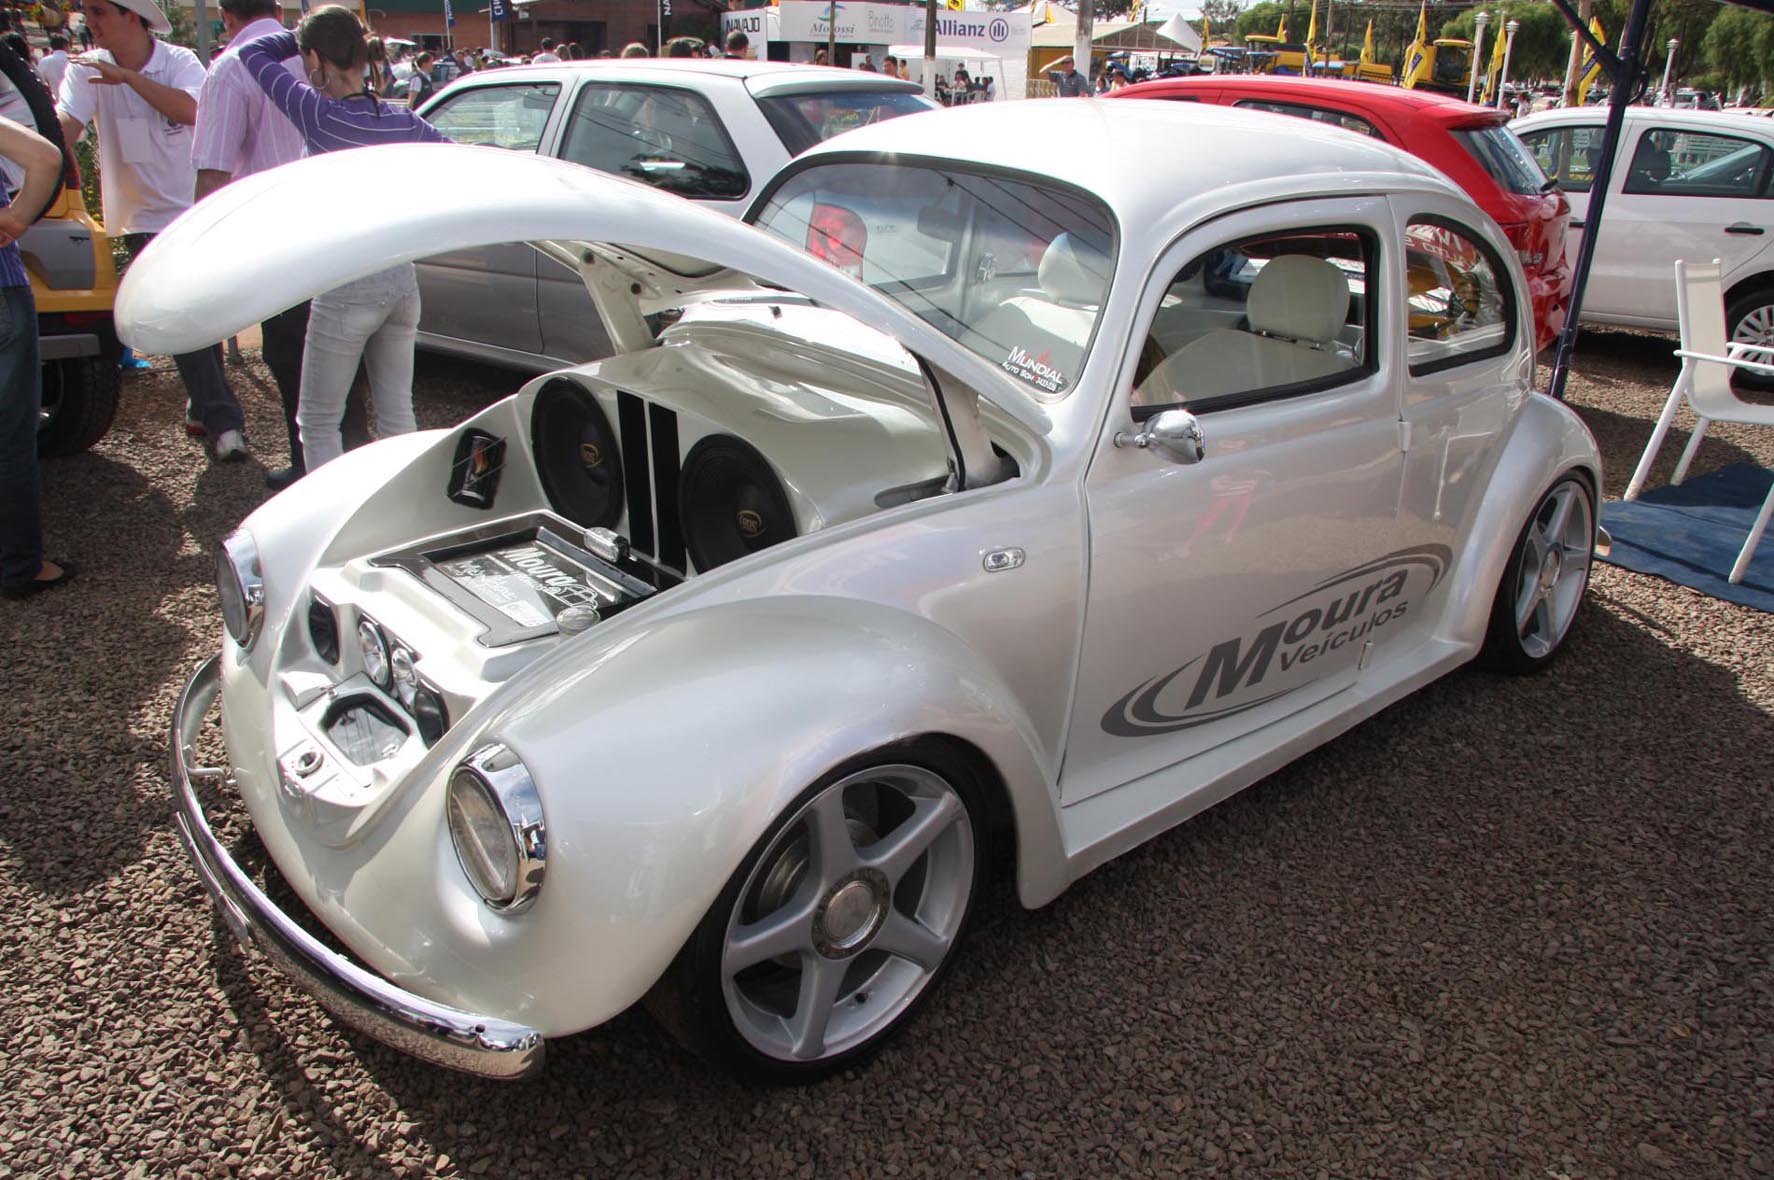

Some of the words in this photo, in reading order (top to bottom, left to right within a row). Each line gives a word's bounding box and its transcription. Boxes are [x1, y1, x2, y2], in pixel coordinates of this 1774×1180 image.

[726, 17, 760, 33] NAVAJO
[811, 23, 855, 33] Moossi
[935, 20, 985, 37] Allianz
[1002, 361, 1019, 375] AUTO
[1008, 346, 1062, 384] MUNDIAL
[498, 547, 578, 586] Moura
[1184, 569, 1408, 710] Moura
[1281, 601, 1408, 671] Veículos
